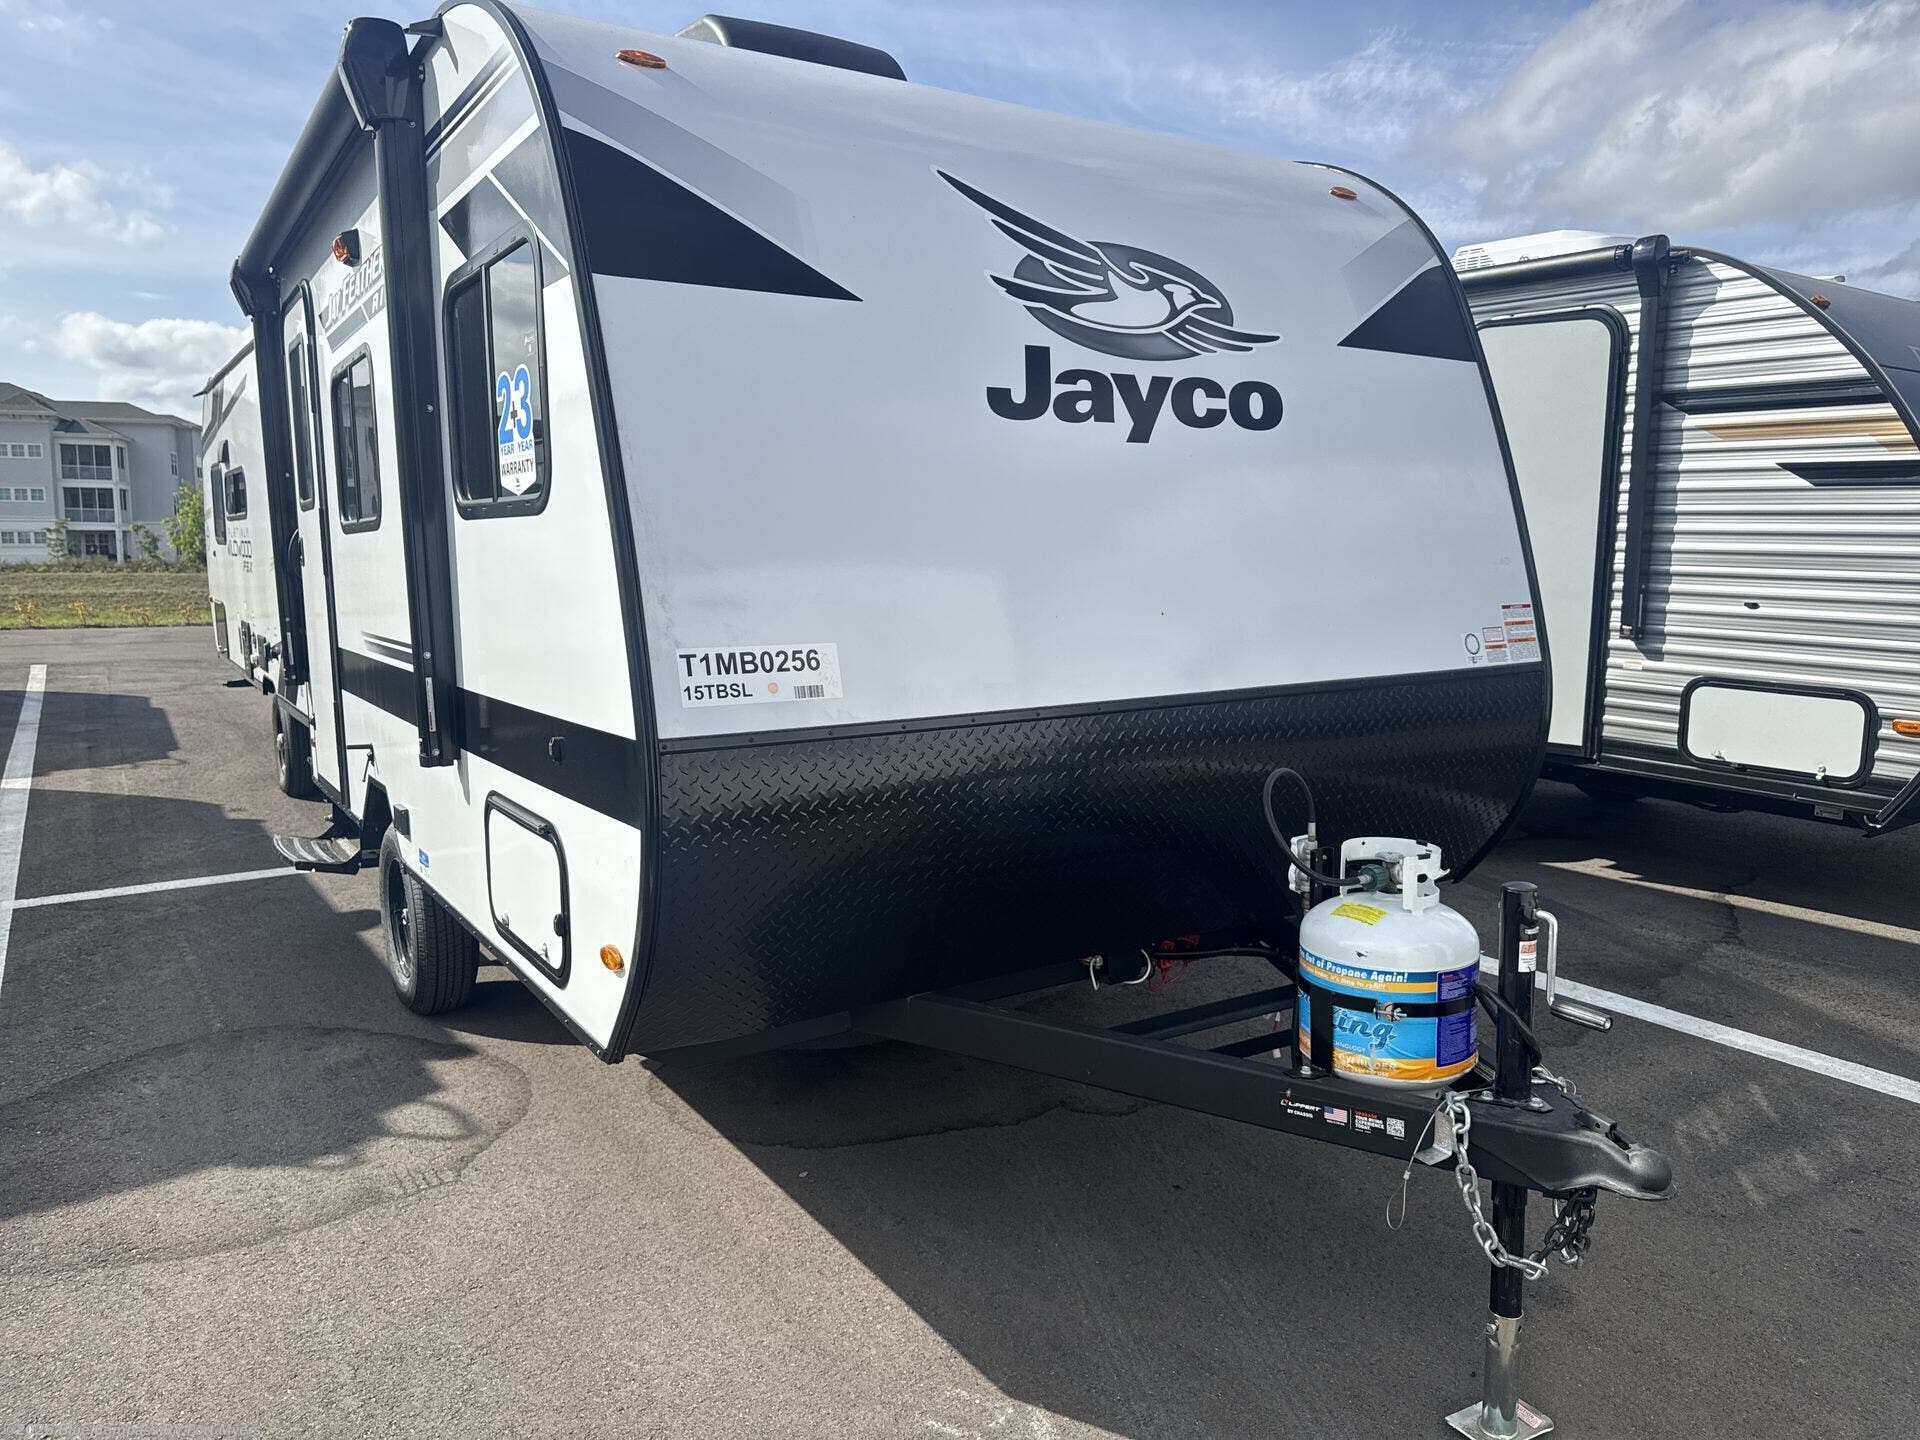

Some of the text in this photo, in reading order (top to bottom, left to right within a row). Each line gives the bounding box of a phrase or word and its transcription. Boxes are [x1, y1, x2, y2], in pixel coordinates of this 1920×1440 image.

[986, 344, 1283, 444] Jayco
[500, 440, 533, 457] YEAR YEAR
[501, 458, 534, 476] WARRANTY
[679, 649, 821, 677] T1MB0256
[683, 683, 753, 700] 15TBSL
[1305, 952, 1315, 965] Out
[1316, 959, 1325, 969] of
[1326, 961, 1368, 979] Propane
[1370, 970, 1408, 983] Again!
[1333, 1011, 1396, 1050] ing
